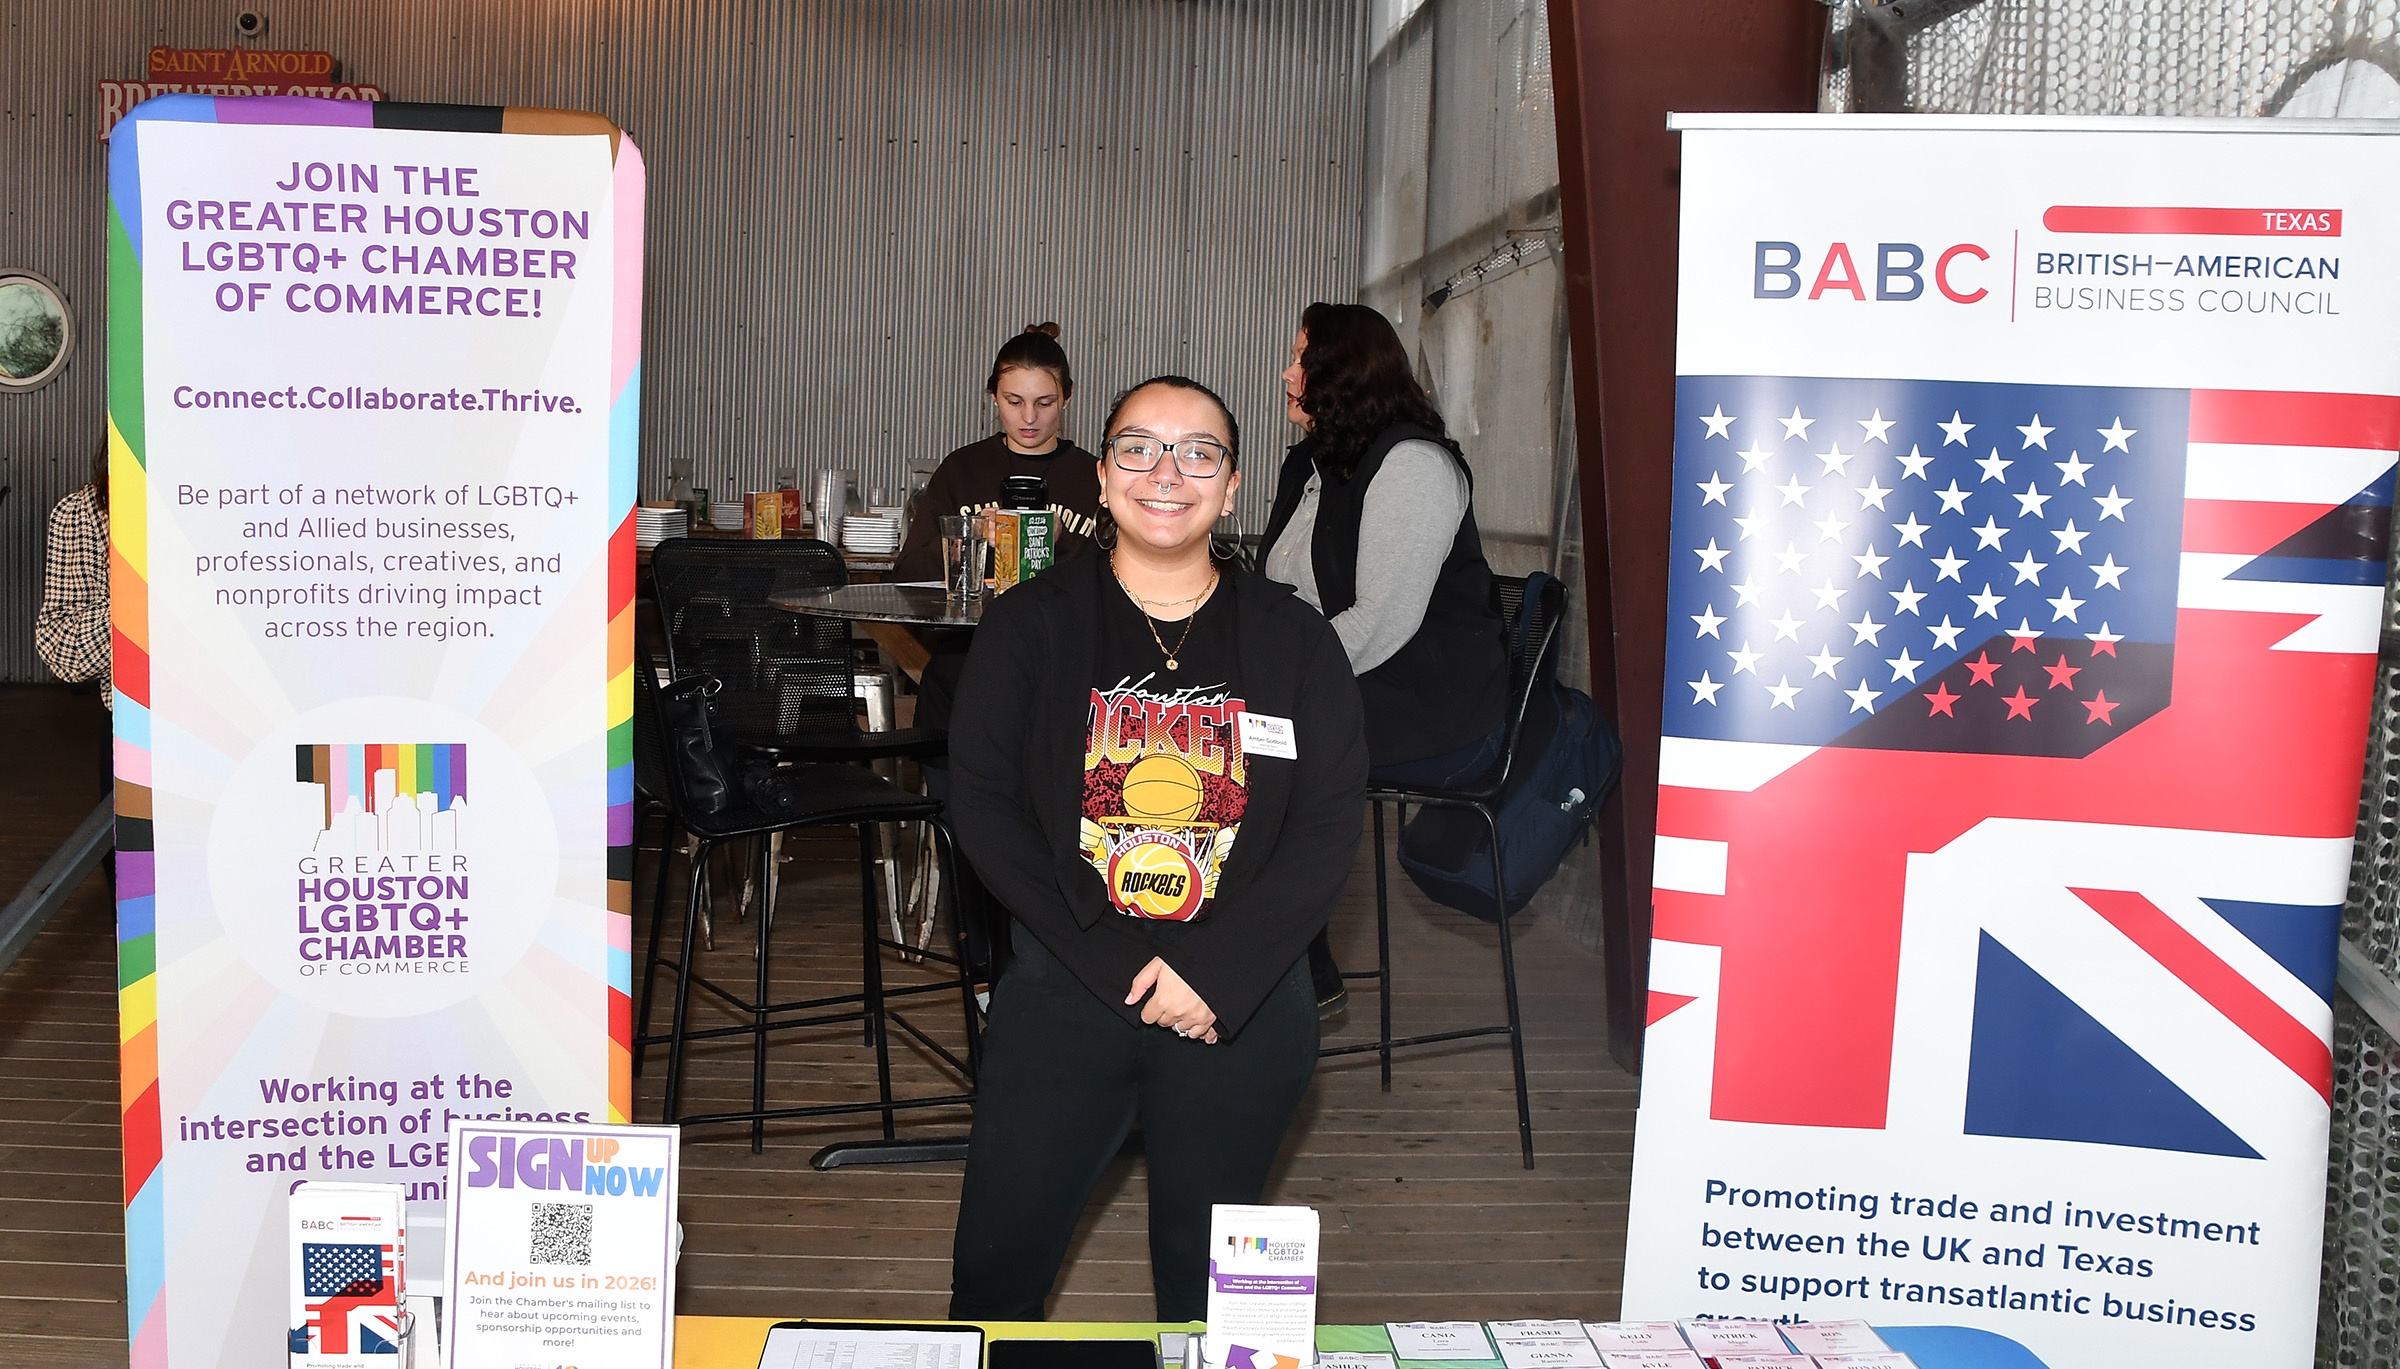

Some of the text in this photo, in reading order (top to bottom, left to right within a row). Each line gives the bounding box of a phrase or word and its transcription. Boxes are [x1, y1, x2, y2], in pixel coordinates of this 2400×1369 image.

[150, 48, 333, 81] SAINT ARNOLD
[276, 161, 480, 197] JOIN THE
[166, 199, 589, 240] GREATER HOUSTON
[2262, 212, 2331, 232] TEXAS
[181, 241, 577, 279] LGBTQ+ CHAMBER
[1754, 240, 1991, 304] BABC
[215, 282, 542, 318] OF COMMERCE!
[2034, 286, 2341, 316] BUSINESS COUNCIL
[178, 483, 579, 509] Be part of a network of LGBTQ+
[242, 517, 515, 542] and Allied businesses,
[196, 550, 561, 576] professionals, creatives, and
[216, 583, 542, 610] nonprofits driving impact
[265, 617, 494, 642] across the region.
[1100, 671, 1231, 714] Houston
[1085, 688, 1246, 788] OCKET
[1115, 832, 1181, 858] HOUSTON
[298, 855, 468, 874] GREATER
[299, 876, 468, 902] HOUSTON
[299, 902, 468, 933] LGBTQ+
[299, 935, 468, 961] CHAMBER
[300, 961, 469, 976] OF COMMERCE
[260, 1073, 513, 1106] Working at the
[179, 1108, 392, 1142] intersection
[400, 1107, 431, 1135] of
[245, 1145, 307, 1173] and
[319, 1143, 375, 1170] the
[468, 1135, 584, 1191] SIGN
[586, 1138, 620, 1163] UP
[585, 1165, 664, 1197] NOW
[302, 1220, 334, 1230] BABC
[1704, 1179, 2261, 1246] Promoting trade and investment
[1701, 1222, 2154, 1279] between the UK and Texas
[464, 1271, 657, 1290] And join us in 2026!
[470, 1296, 650, 1310] Join the Chamber's mailing list to
[1698, 1266, 2257, 1333] to support transatlantic business
[476, 1323, 641, 1336] sponsorship opportunities and
[480, 1309, 639, 1324] hear about upcoming events,
[543, 1338, 575, 1347] more!
